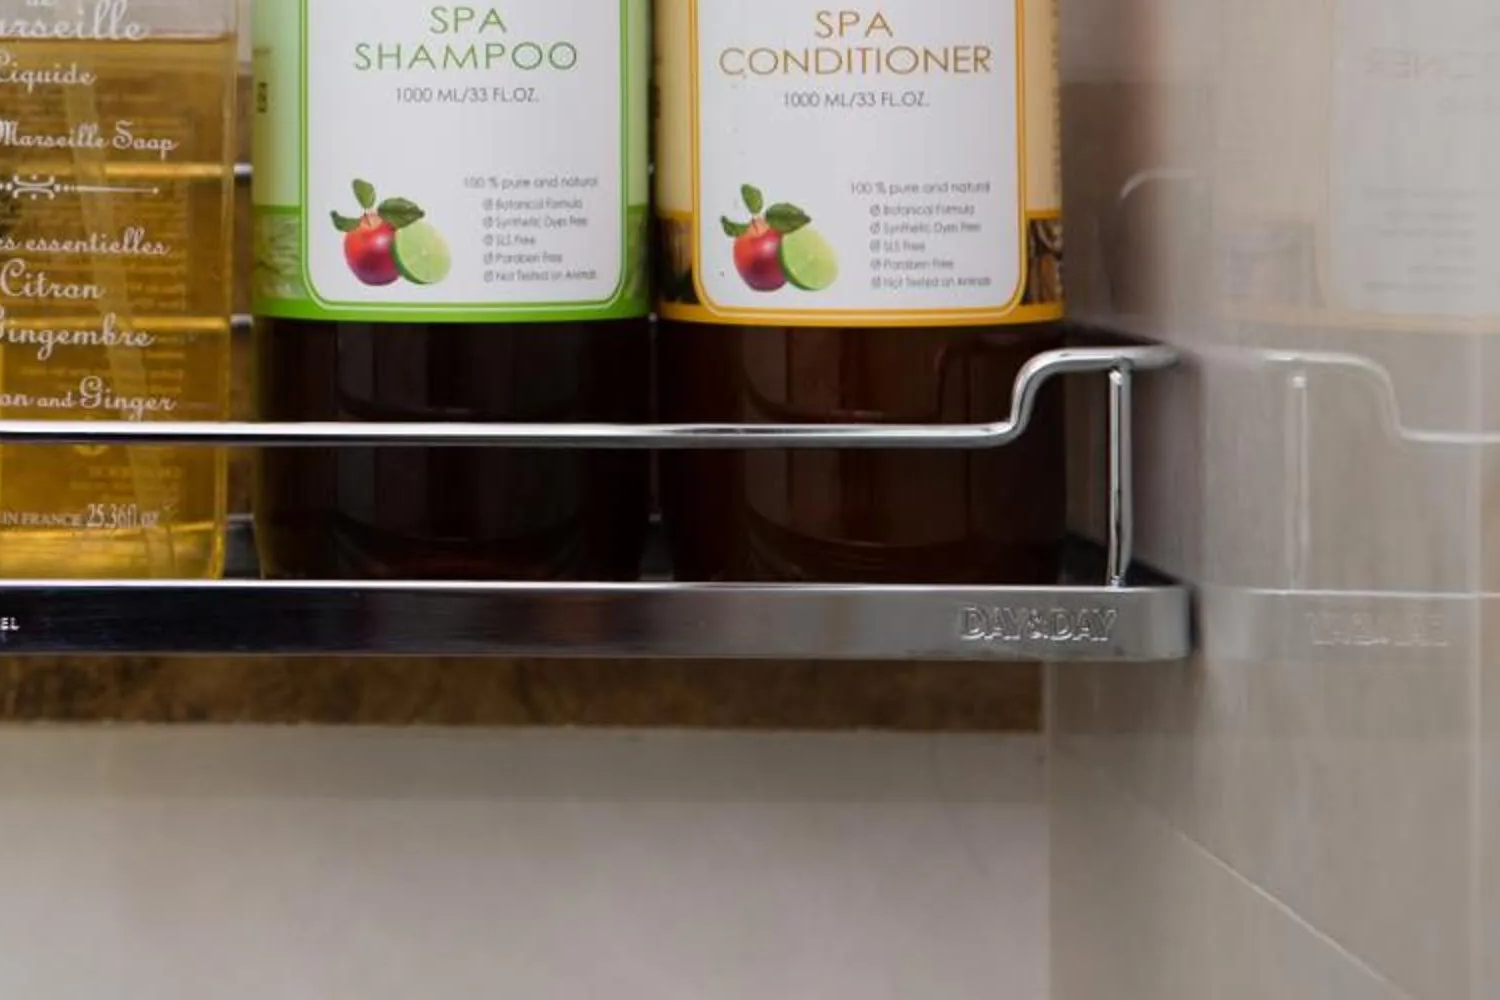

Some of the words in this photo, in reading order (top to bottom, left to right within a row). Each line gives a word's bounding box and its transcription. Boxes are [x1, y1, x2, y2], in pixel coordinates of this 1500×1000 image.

[429, 6, 508, 34] SPA
[814, 10, 894, 39] SPA
[353, 41, 578, 71] SHAMPOO
[718, 45, 992, 76] CONDITIONER
[396, 87, 433, 103] 1000
[437, 86, 488, 103] ML/33
[783, 91, 821, 108] 1000
[824, 91, 876, 108] ML/33
[112, 120, 179, 159] Soap
[501, 178, 531, 191] pure
[533, 175, 559, 188] and
[560, 175, 598, 188] natural
[889, 183, 920, 197] pure
[922, 181, 949, 194] and
[951, 181, 990, 194] natural
[25, 227, 171, 256] essentielles
[0, 258, 104, 299] Citron
[37, 390, 77, 408] and
[78, 375, 177, 421] Ginger
[22, 512, 82, 527] FRANCE
